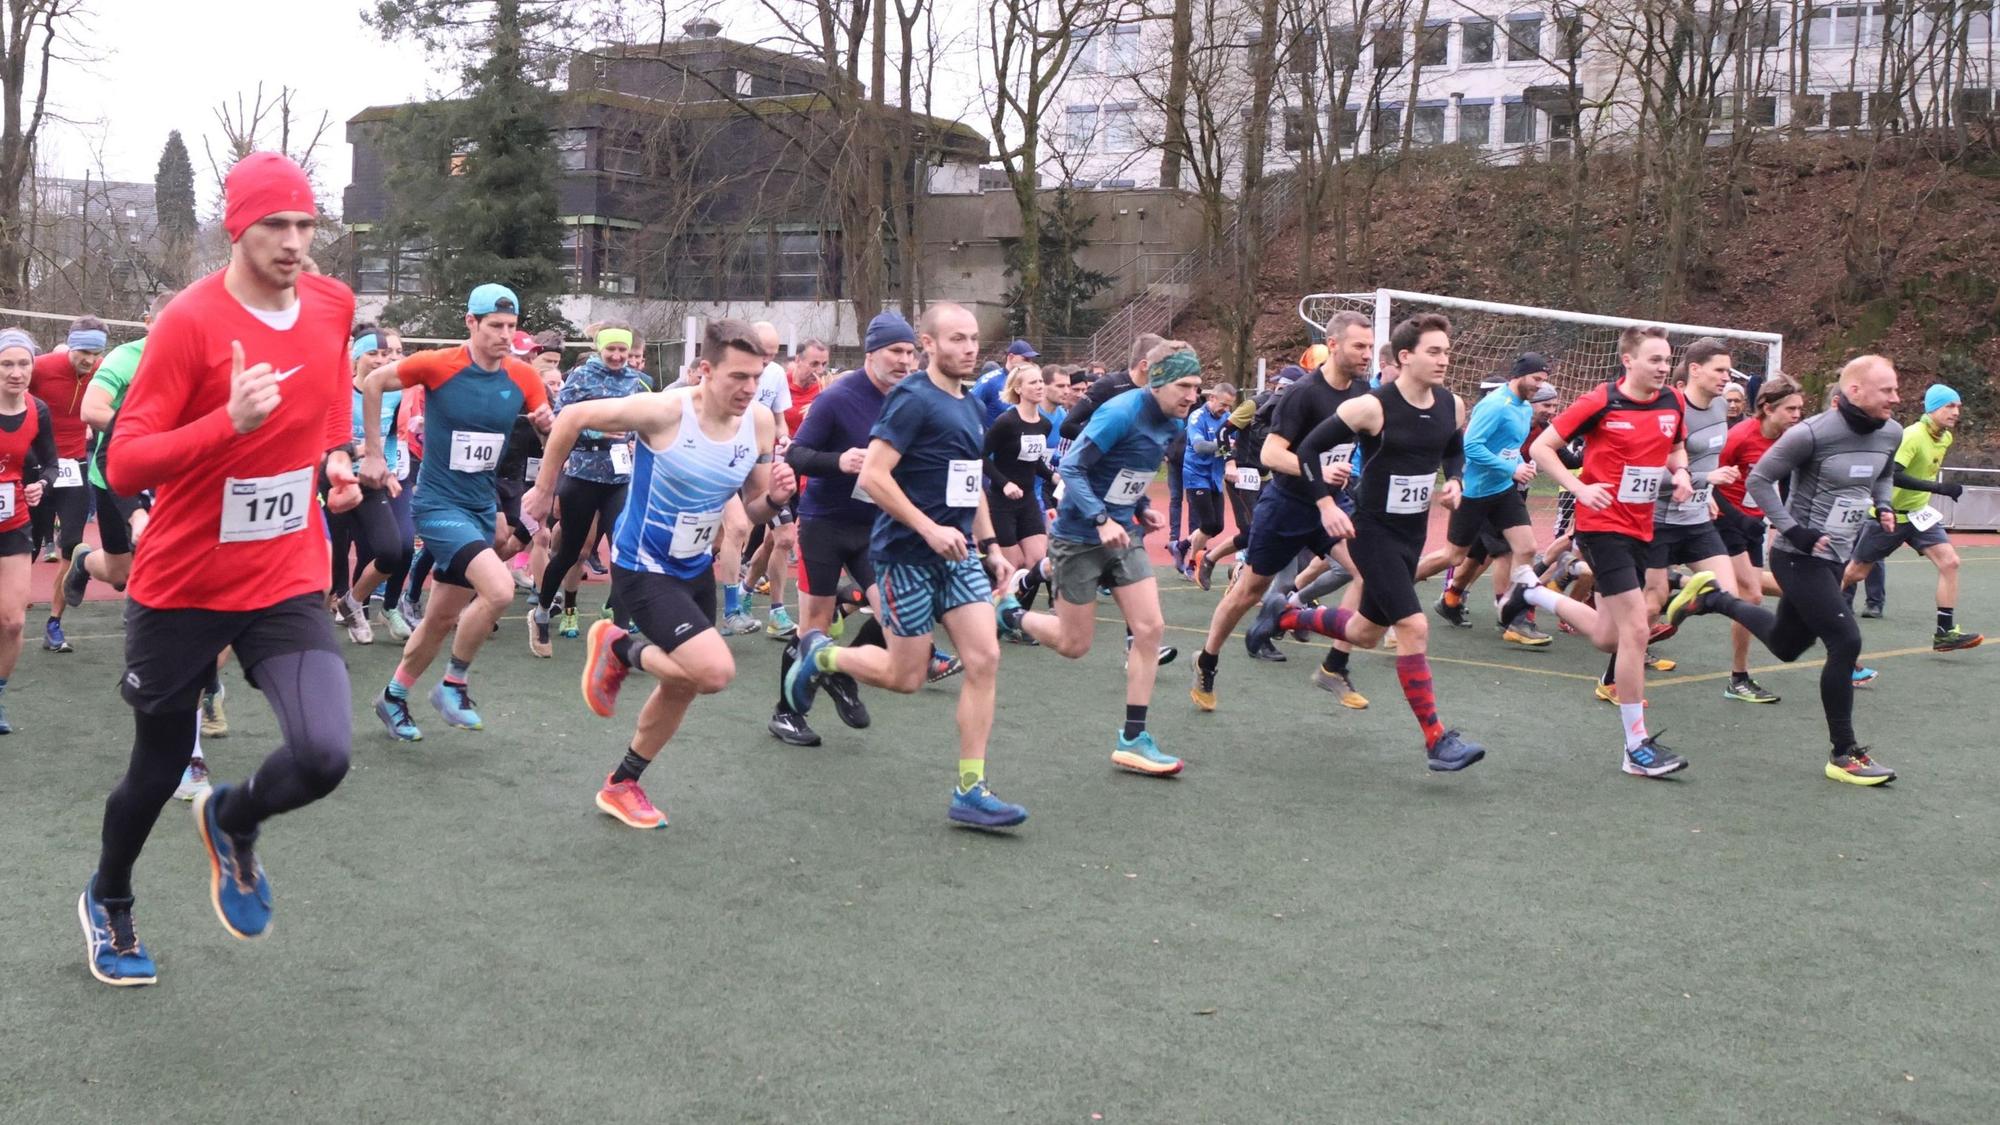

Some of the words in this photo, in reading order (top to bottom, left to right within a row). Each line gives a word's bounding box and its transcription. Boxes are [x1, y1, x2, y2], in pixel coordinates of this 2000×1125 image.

[464, 445, 493, 461] 140
[1028, 443, 1042, 454] 223
[1243, 475, 1258, 484] 103
[1632, 478, 1657, 492] 215
[1122, 482, 1145, 495] 190
[1401, 486, 1429, 502] 218
[246, 492, 293, 522] 170
[1841, 510, 1864, 523] 135
[693, 526, 712, 544] 74
